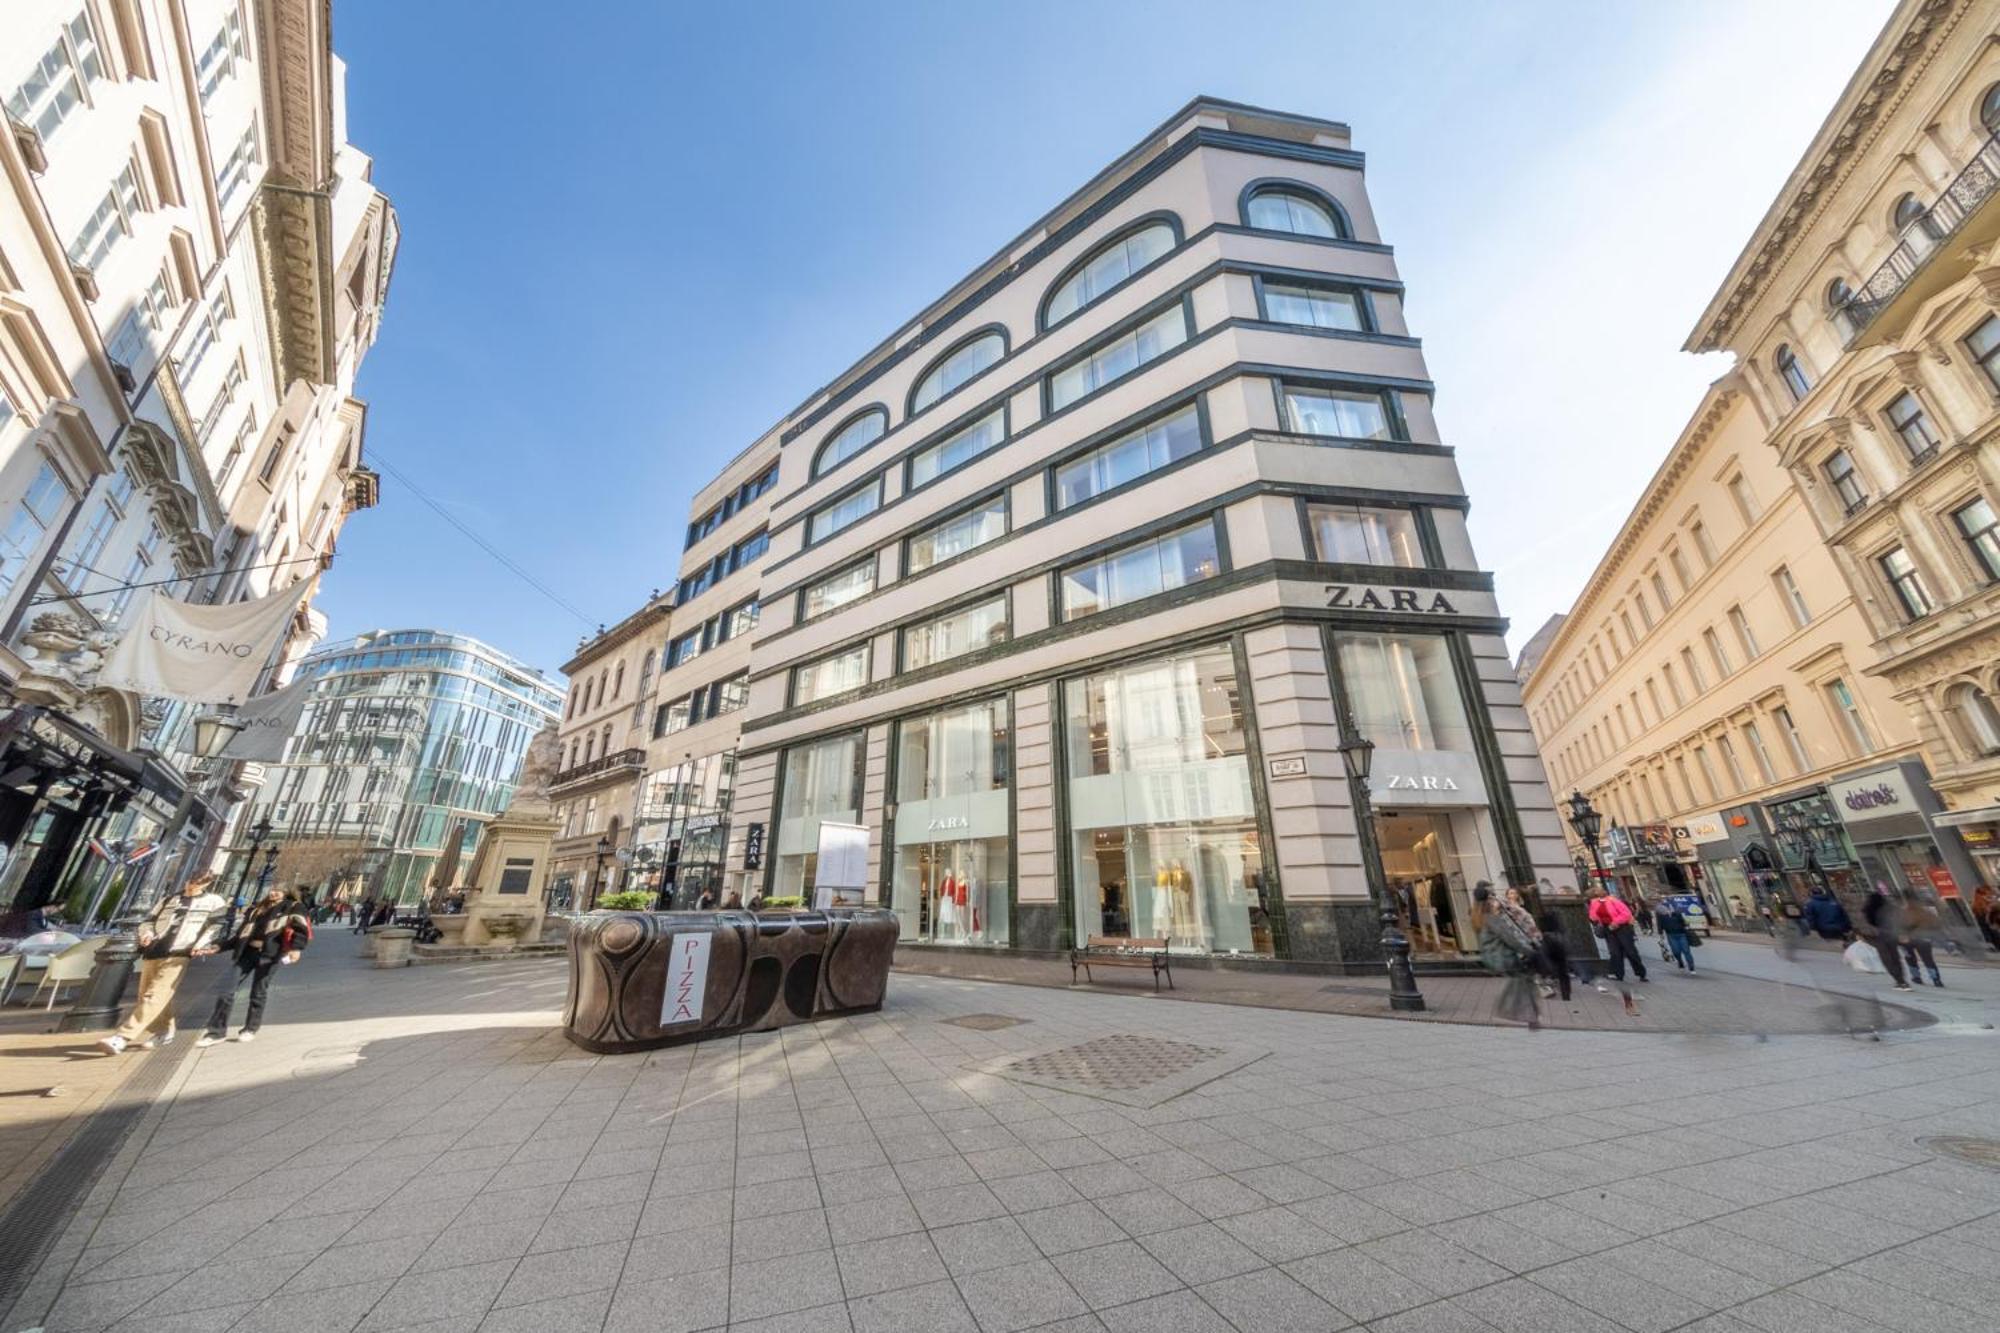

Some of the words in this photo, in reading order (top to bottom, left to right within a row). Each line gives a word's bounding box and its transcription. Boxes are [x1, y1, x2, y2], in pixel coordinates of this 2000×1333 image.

[1324, 585, 1460, 614] ZARA
[150, 625, 252, 658] CYRANO
[1387, 775, 1460, 790] ZARA
[928, 816, 970, 831] ZARA
[749, 828, 761, 864] ZARA
[672, 940, 699, 1021] PIZZA
